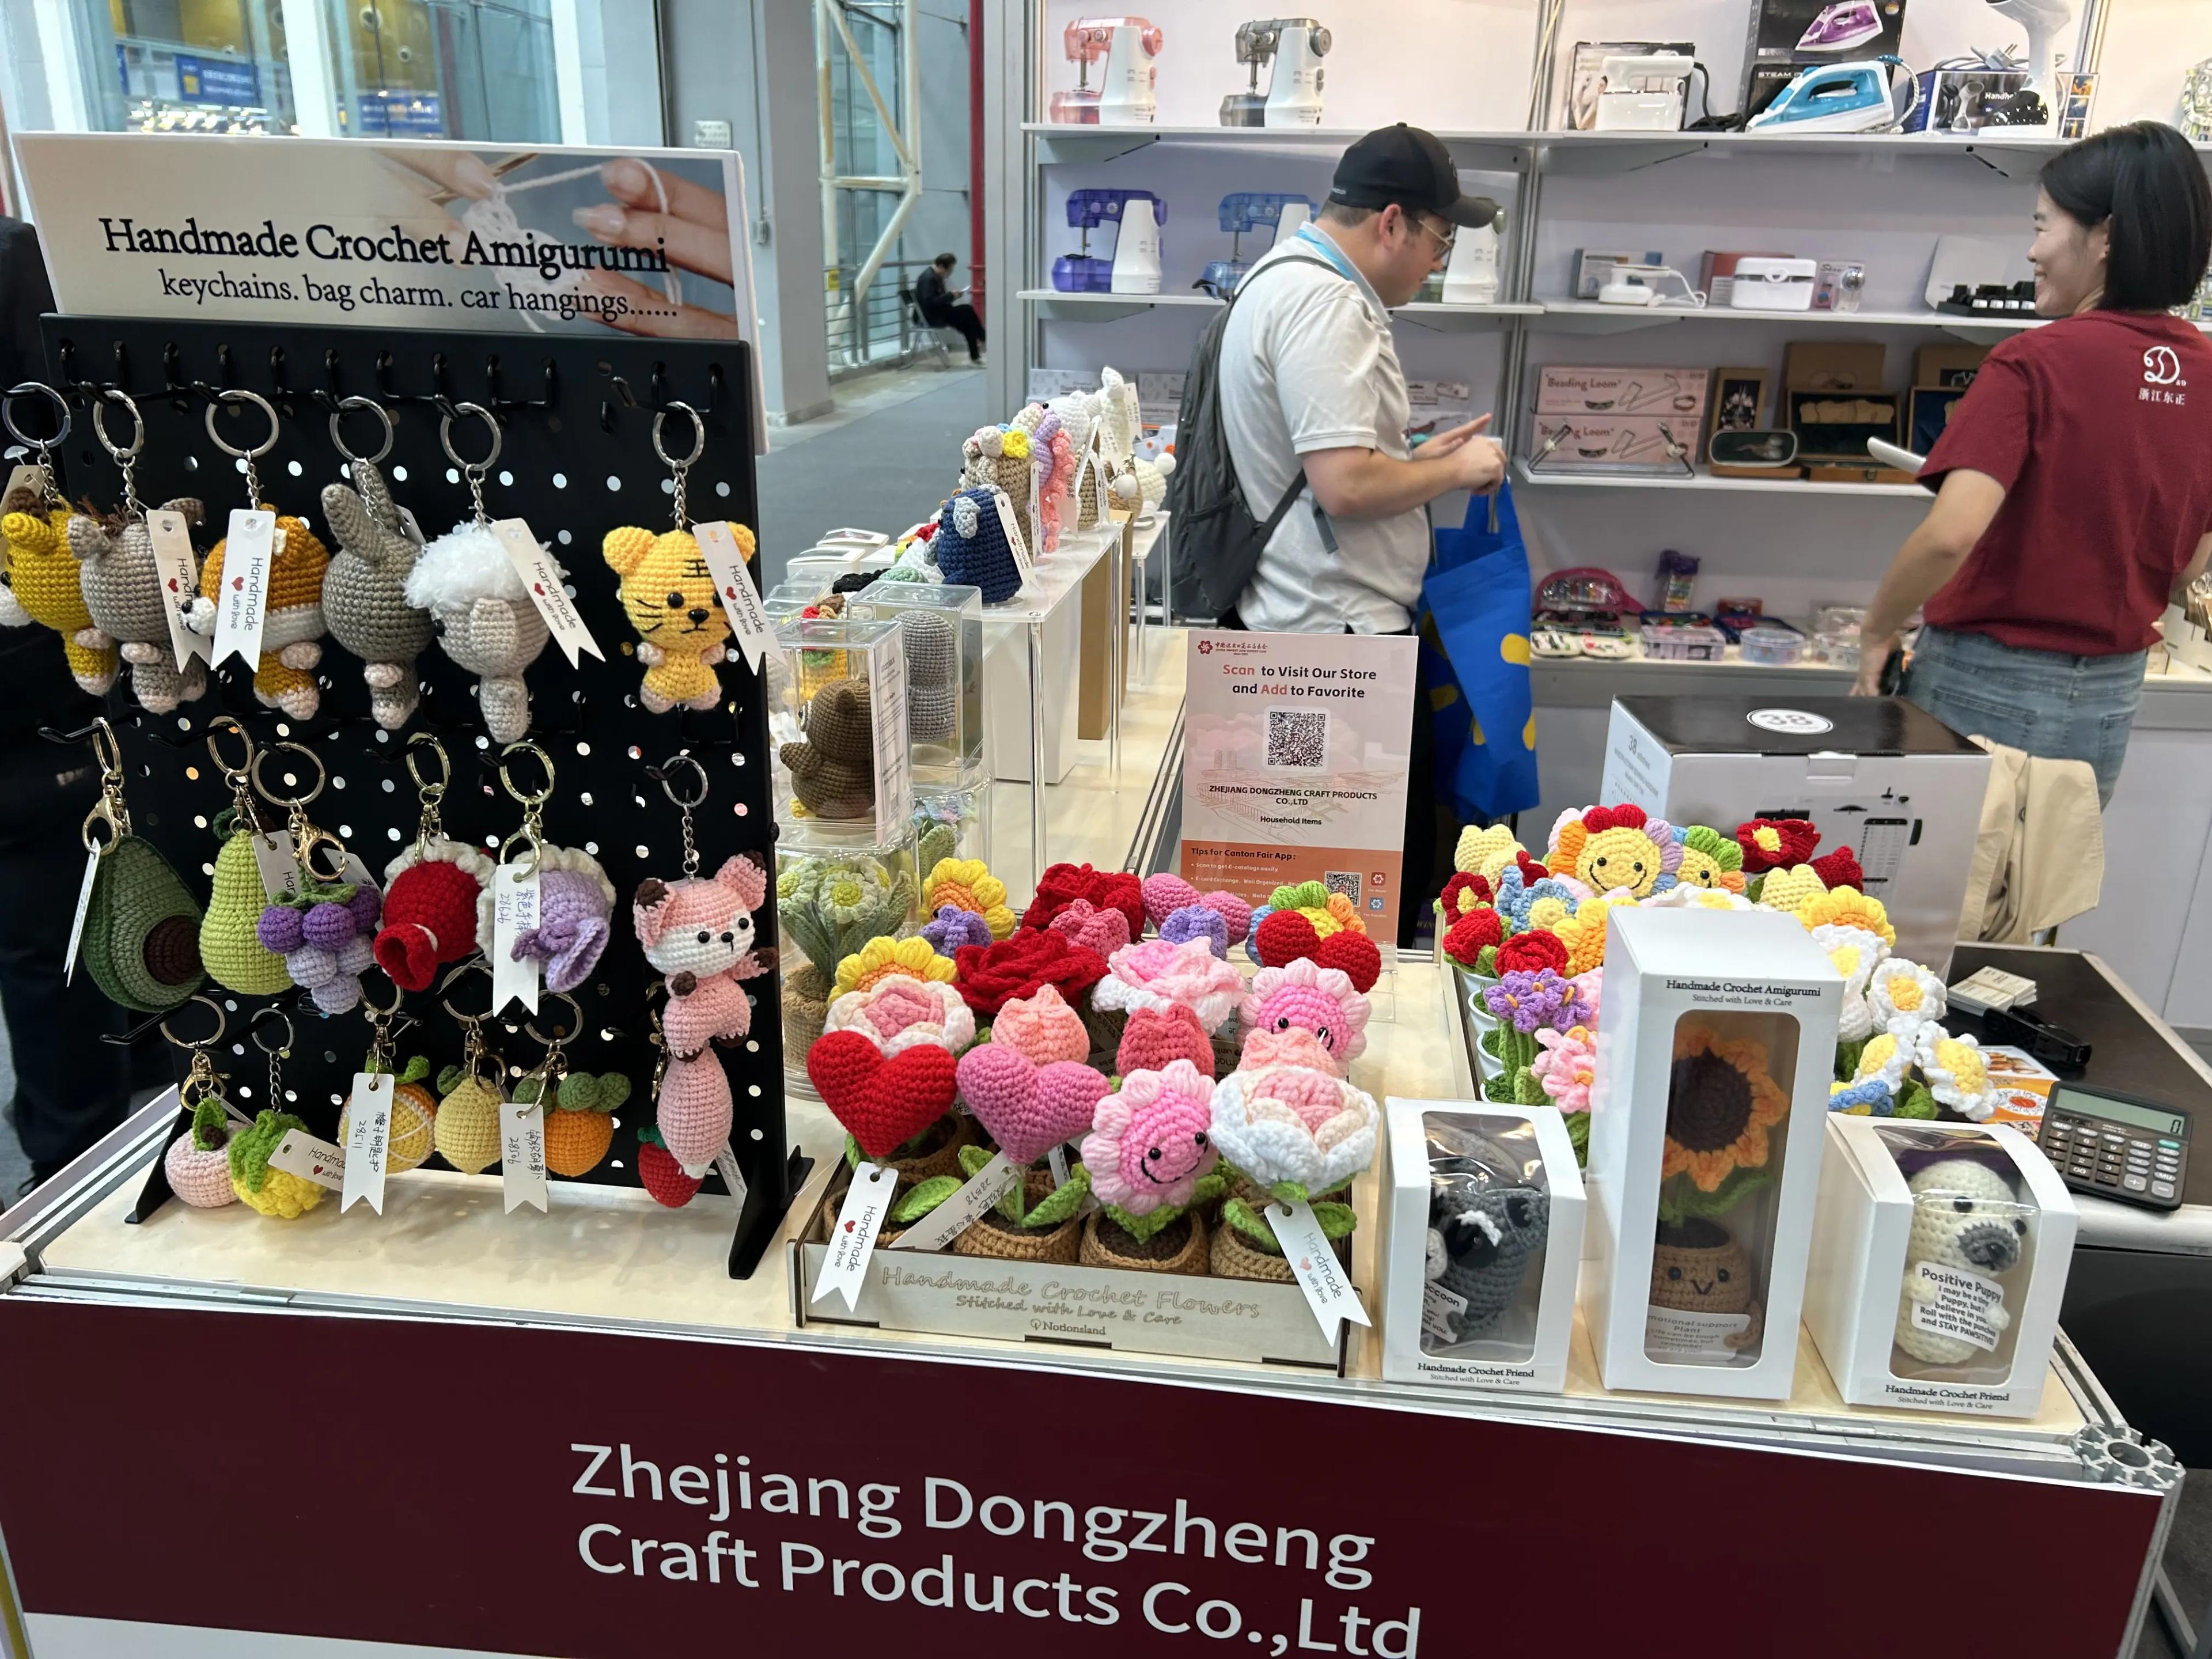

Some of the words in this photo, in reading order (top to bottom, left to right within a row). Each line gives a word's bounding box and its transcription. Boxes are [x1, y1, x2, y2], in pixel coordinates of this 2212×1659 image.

[98, 217, 299, 258] Handmade
[305, 224, 454, 265] Crochet
[460, 230, 671, 281] Amigurumi
[157, 268, 299, 305] keychains.
[301, 273, 355, 312] bag
[359, 276, 453, 307] charm.
[460, 289, 501, 309] car
[2138, 387, 2186, 406] 浙江东正
[1010, 522, 1030, 569] Handmade
[176, 557, 195, 605] Handm
[244, 557, 264, 631] Handmade
[532, 562, 577, 629] Handmade
[729, 565, 765, 634] Handmade
[542, 599, 555, 613] with
[732, 603, 743, 618] with
[230, 610, 241, 630] love
[1222, 664, 1255, 676] Scan
[1261, 665, 1275, 676] to
[1278, 665, 1309, 677] Visit
[1312, 667, 1337, 678] Our
[1340, 668, 1377, 680] Store
[1232, 683, 1257, 694] and
[1260, 684, 1287, 695] Add
[1290, 685, 1304, 696] to
[1307, 686, 1365, 698] Favorite
[1628, 734, 1637, 755] 38
[1209, 785, 1248, 794] ZHEJIANG
[1249, 787, 1302, 796] DONGZHENG
[1304, 790, 1331, 798] CRAFT
[1332, 791, 1377, 800] PRODUCTS
[1275, 797, 1308, 806] CO.,LTD
[1260, 816, 1300, 824] Household
[1191, 847, 1209, 857] Tips
[1224, 850, 1255, 858] Canton
[1665, 979, 1721, 991] Handmade
[1722, 983, 1763, 994] Crochet
[1764, 985, 1821, 997] Amigurumi
[1692, 994, 1724, 1003] Stitched
[1725, 995, 1741, 1003] with
[1744, 997, 1763, 1005] Love
[2170, 1119, 2182, 1134] 0
[308, 1146, 346, 1169] Handma
[507, 1137, 521, 1164] 28506
[332, 1172, 343, 1181] love
[839, 1235, 849, 1250] with
[846, 1205, 877, 1271] Handmade
[834, 1250, 846, 1267] love
[1304, 1232, 1344, 1300] Handmade
[882, 1266, 1032, 1296] Handmade
[1041, 1281, 1147, 1307] Crochet
[1156, 1290, 1260, 1319] Flowers
[1307, 1272, 1319, 1288] with
[1315, 1286, 1328, 1304] love
[1922, 1267, 1973, 1290] Positive
[1975, 1281, 2001, 1304] Puppy
[1944, 1287, 1961, 1297] may
[1963, 1290, 1972, 1300] be
[1424, 1282, 1460, 1308] accoon
[956, 1295, 1027, 1312] Stitched
[1032, 1301, 1074, 1315] with
[1077, 1305, 1118, 1319] Love
[1122, 1309, 1137, 1322] &
[1143, 1311, 1183, 1325] Care
[1935, 1301, 1965, 1316] believe
[1967, 1310, 1974, 1319] in
[1970, 1302, 1981, 1312] but
[1043, 1321, 1107, 1336] Notionsland
[1648, 1315, 1695, 1326] motional
[1920, 1306, 1937, 1317] Roll
[1938, 1312, 1957, 1323] with
[1959, 1317, 1972, 1327] the
[1973, 1323, 1996, 1338] punches
[1921, 1317, 1937, 1326] and
[1938, 1320, 1959, 1332] STAY
[1417, 1362, 1467, 1374] Handmade
[1468, 1366, 1504, 1376] Crochet
[1505, 1369, 1535, 1377] Friend
[1430, 1373, 1458, 1382] Stitched
[1459, 1375, 1475, 1383] with
[1885, 1384, 1937, 1397] Handmade
[1939, 1389, 1978, 1399] Crochet
[1979, 1392, 2010, 1402] Friend
[1897, 1396, 1927, 1404] Stitched
[570, 1442, 902, 1539] Zhejiang
[925, 1476, 1376, 1591] Dongzheng
[578, 1522, 760, 1588] Craft
[780, 1541, 1120, 1626] Products
[1142, 1581, 1421, 1659] Co.,Ltd
